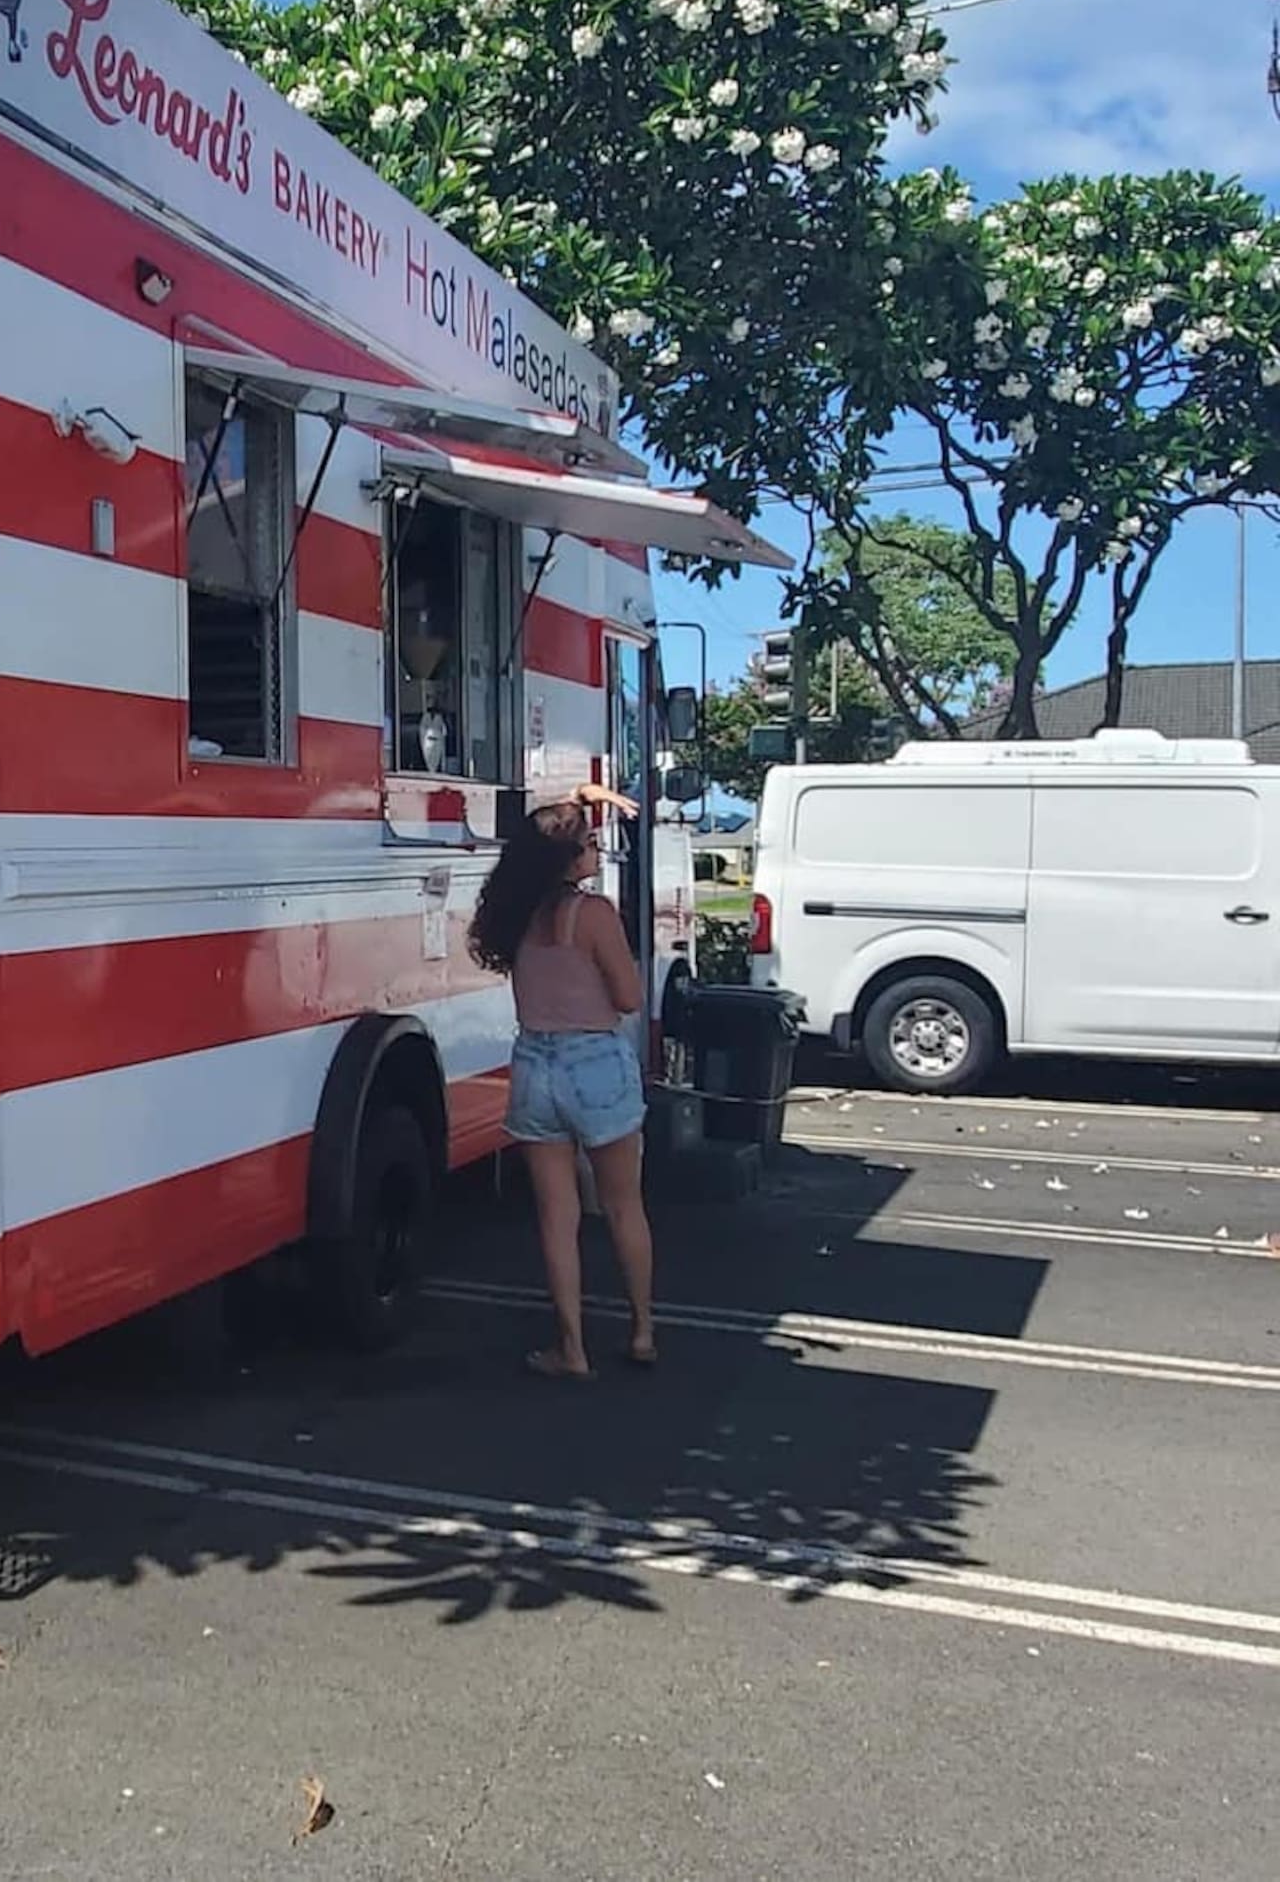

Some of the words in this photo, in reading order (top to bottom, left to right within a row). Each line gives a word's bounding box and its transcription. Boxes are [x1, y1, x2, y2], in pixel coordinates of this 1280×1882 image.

[275, 149, 381, 277] BAKERY
[405, 225, 457, 337] Hot
[466, 274, 590, 425] Malasadas
